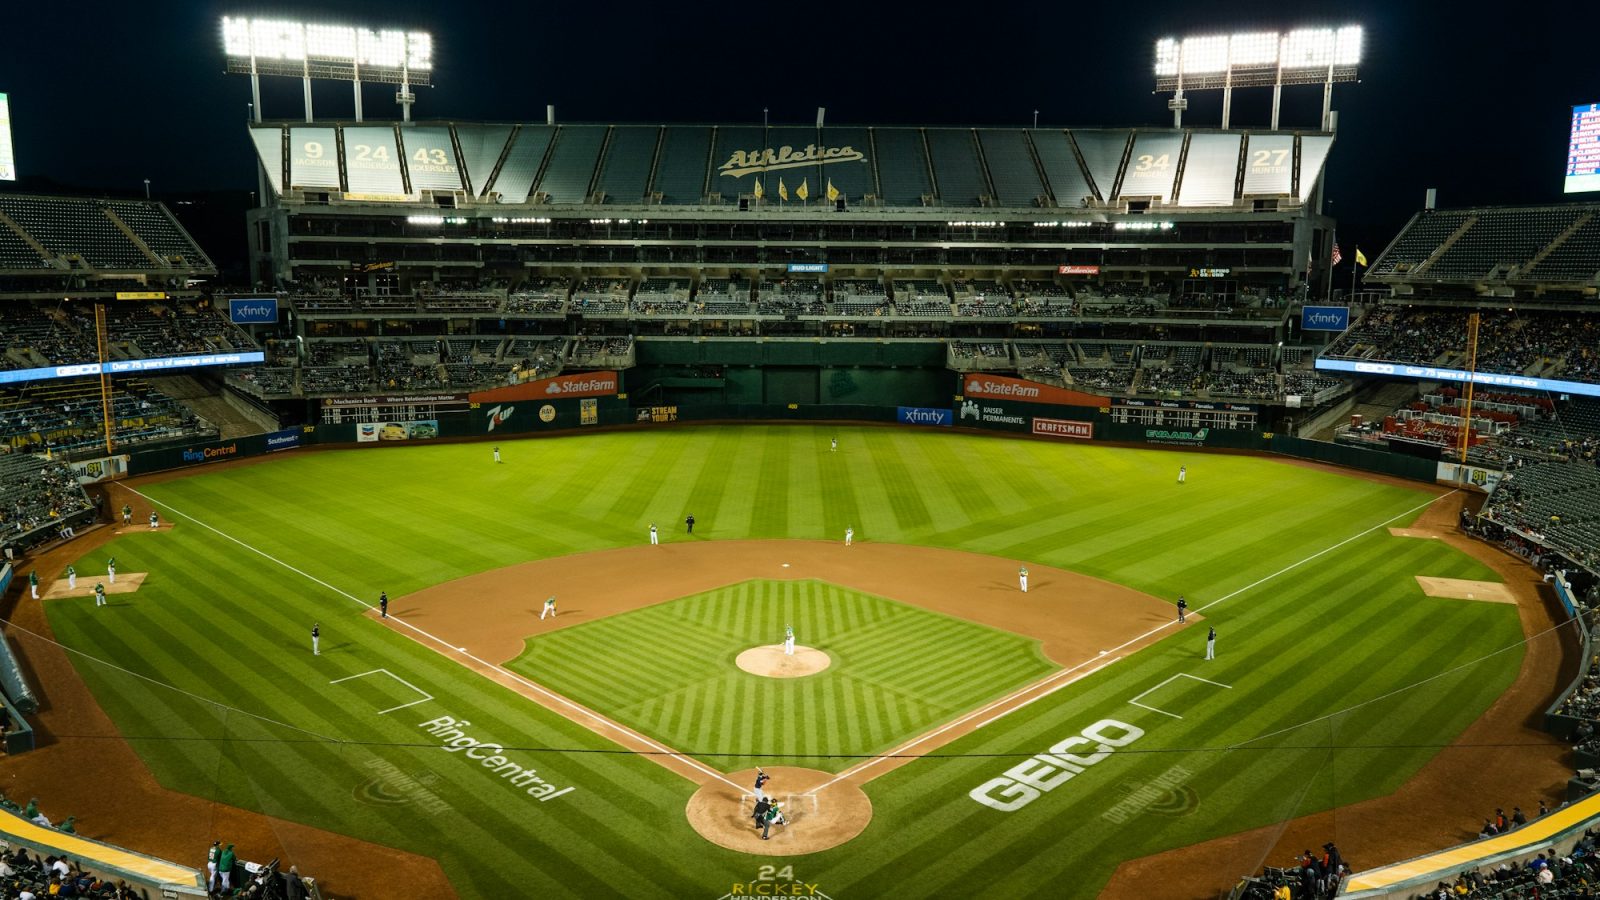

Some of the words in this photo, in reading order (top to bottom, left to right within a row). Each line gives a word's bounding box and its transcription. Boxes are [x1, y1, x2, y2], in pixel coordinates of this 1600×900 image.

[304, 142, 323, 158] 9
[354, 144, 390, 162] 24
[414, 148, 448, 165] 43
[718, 143, 863, 172] Athletics
[1136, 154, 1170, 170] 34
[1252, 150, 1288, 166] 27
[1252, 166, 1288, 174] HUNTER
[236, 306, 271, 318] xfinity
[1308, 313, 1342, 325] xfinity
[144, 362, 164, 370] years
[1406, 367, 1423, 376] Over
[1437, 370, 1456, 379] years
[1458, 370, 1466, 379] of
[652, 406, 678, 414] STREAM
[982, 406, 1004, 415] KAISER
[906, 409, 944, 424] xfinity
[982, 414, 1024, 424] PERMANENTE
[1036, 422, 1088, 434] CRAFTSMAN
[1146, 430, 1170, 438] EVA
[268, 436, 295, 445] Southwest
[184, 444, 236, 461] RingCentral
[88, 462, 101, 473] 811
[1474, 470, 1486, 480] 811
[418, 716, 576, 802] RingCentral
[969, 719, 1145, 812] GEICO
[1149, 764, 1192, 790] WEEK
[758, 864, 794, 881] 24
[732, 883, 818, 895] RICKEY
